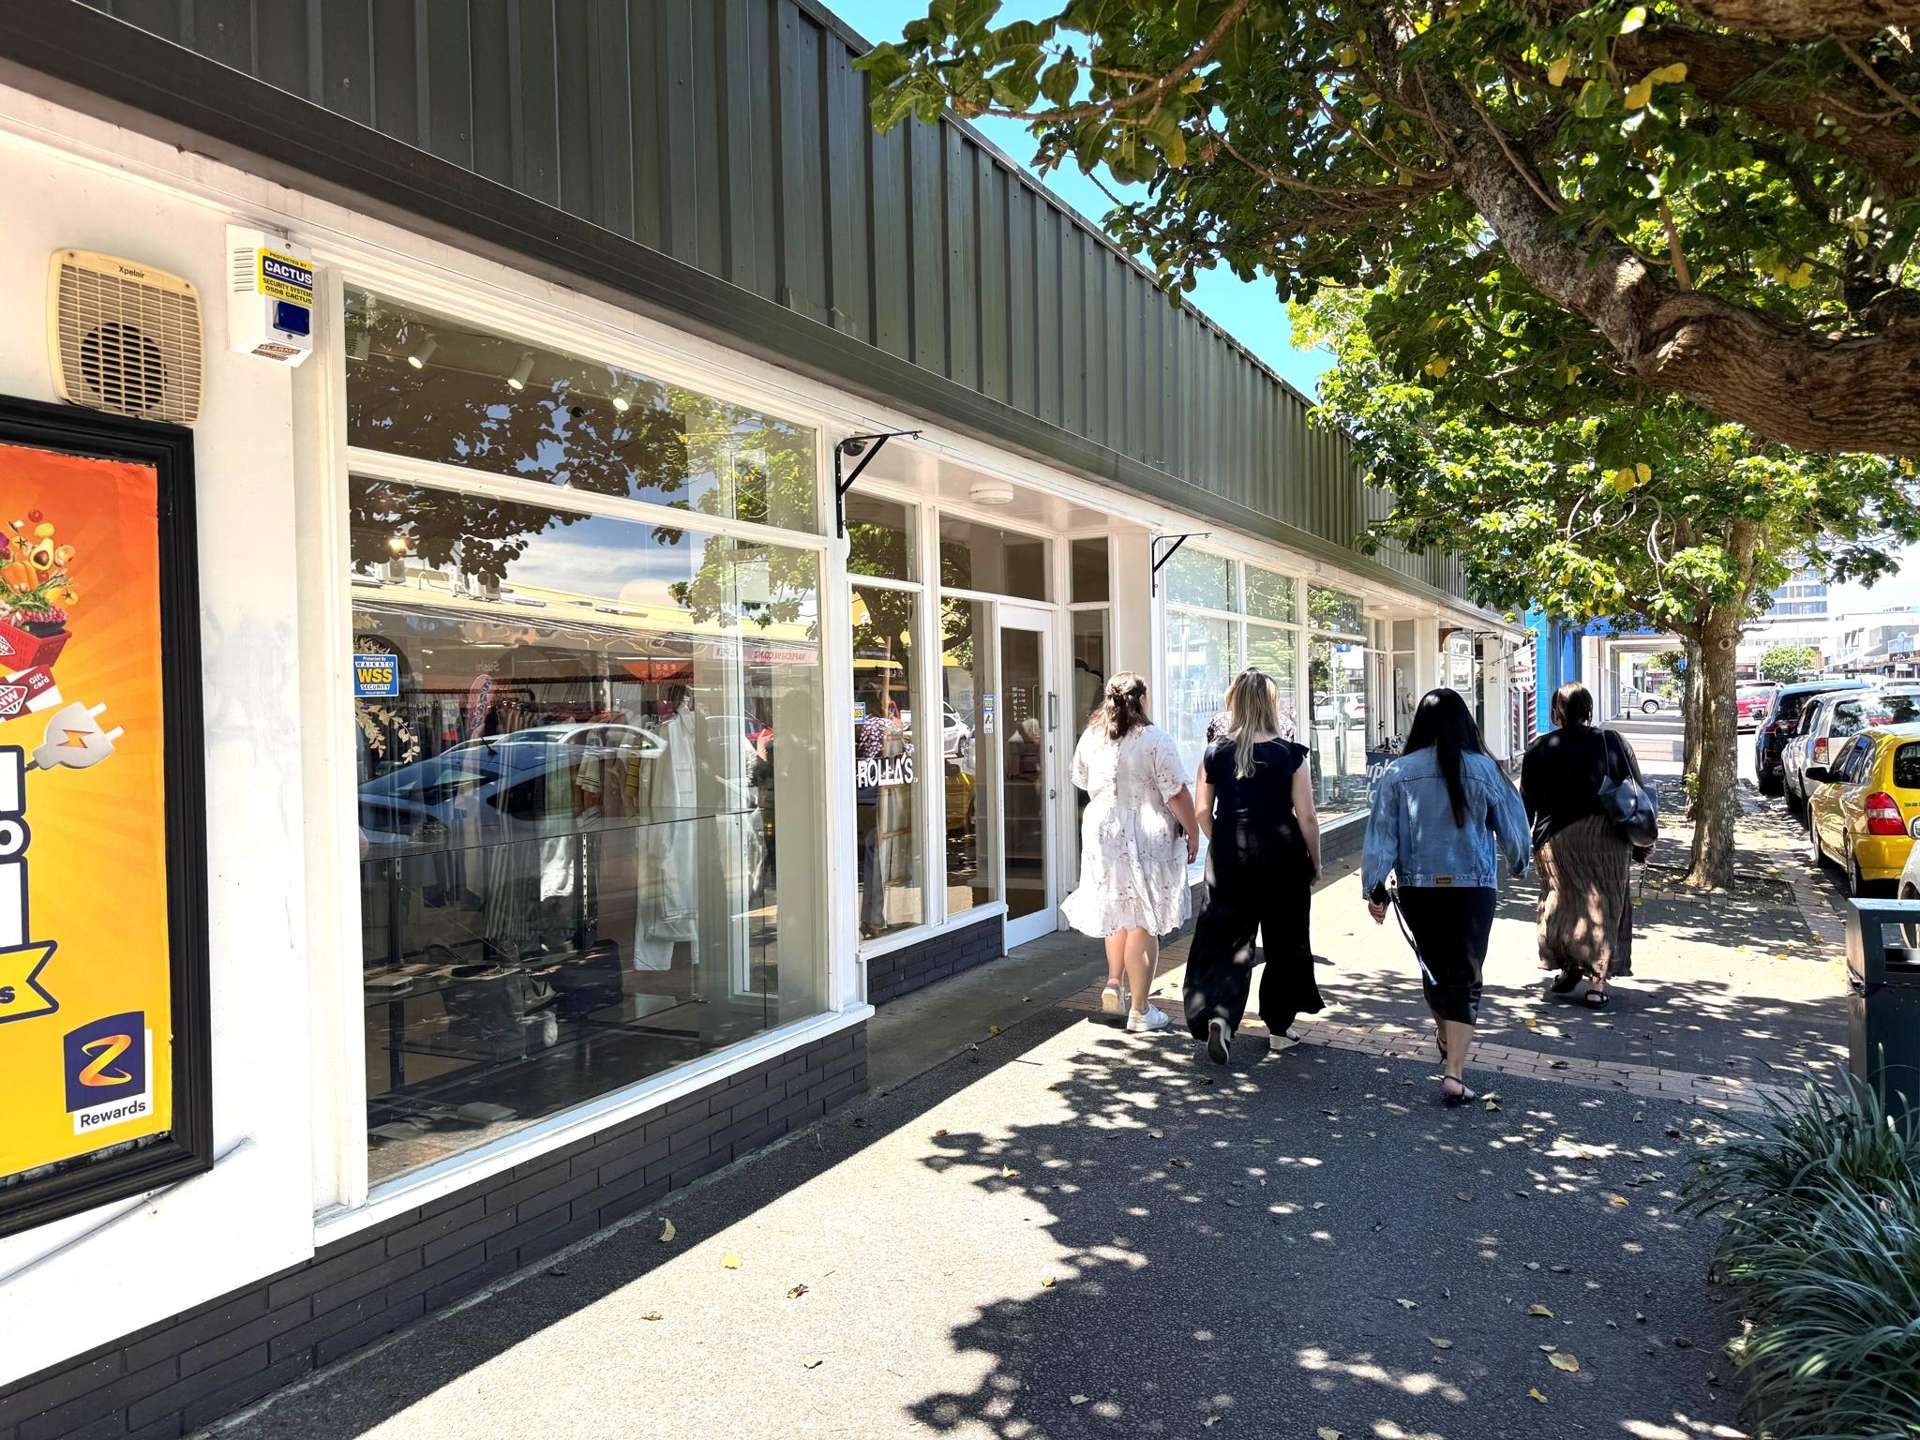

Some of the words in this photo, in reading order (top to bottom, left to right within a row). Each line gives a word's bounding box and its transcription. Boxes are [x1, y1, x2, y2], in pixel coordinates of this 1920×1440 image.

[118, 265, 145, 278] Xpelair
[264, 260, 312, 285] CACTUS
[263, 277, 289, 291] SECURITY
[285, 291, 312, 304] CACTUS
[29, 672, 44, 684] Gift
[357, 668, 393, 683] WSS
[33, 676, 50, 690] card
[858, 751, 914, 788] ROLLA'S
[80, 1100, 146, 1128] Rewards
